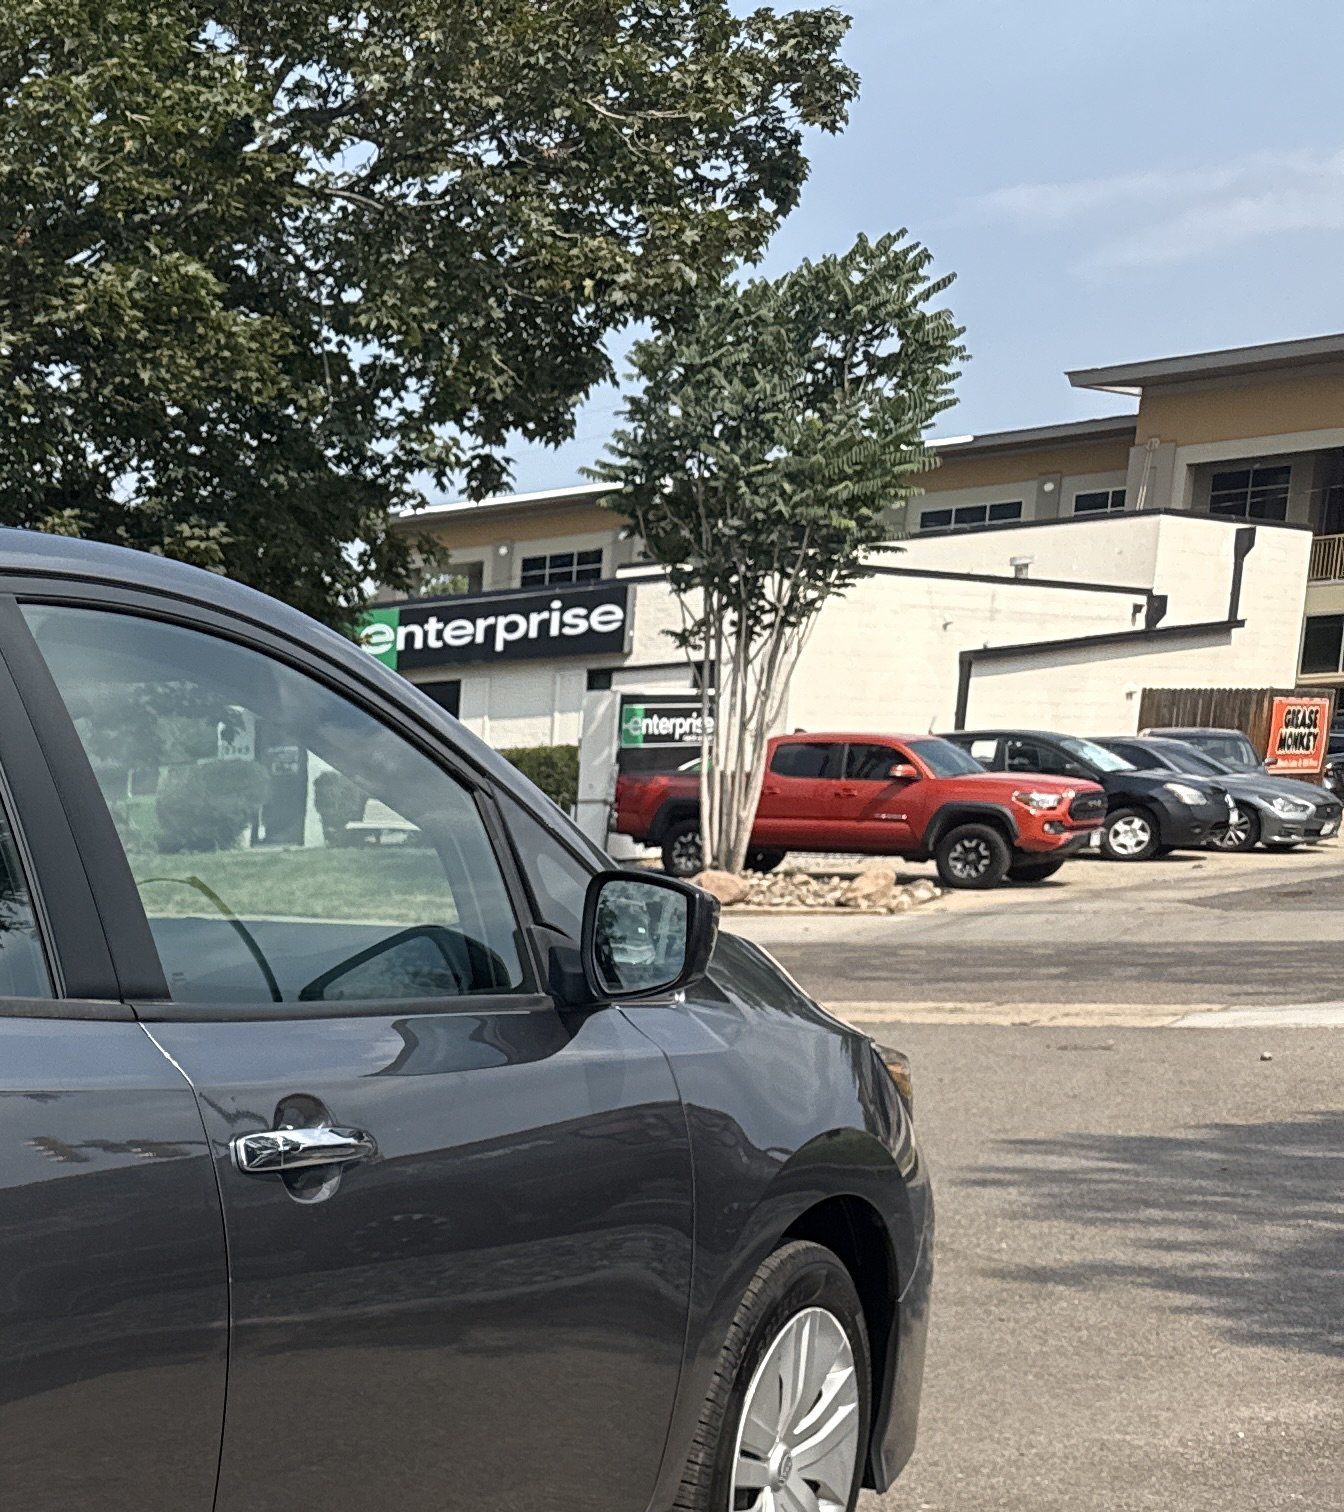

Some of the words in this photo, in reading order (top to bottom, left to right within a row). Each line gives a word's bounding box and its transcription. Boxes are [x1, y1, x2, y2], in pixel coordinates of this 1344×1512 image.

[361, 600, 624, 654] enterprise
[1284, 708, 1319, 730] GREASE
[1277, 731, 1319, 752] MONKEY
